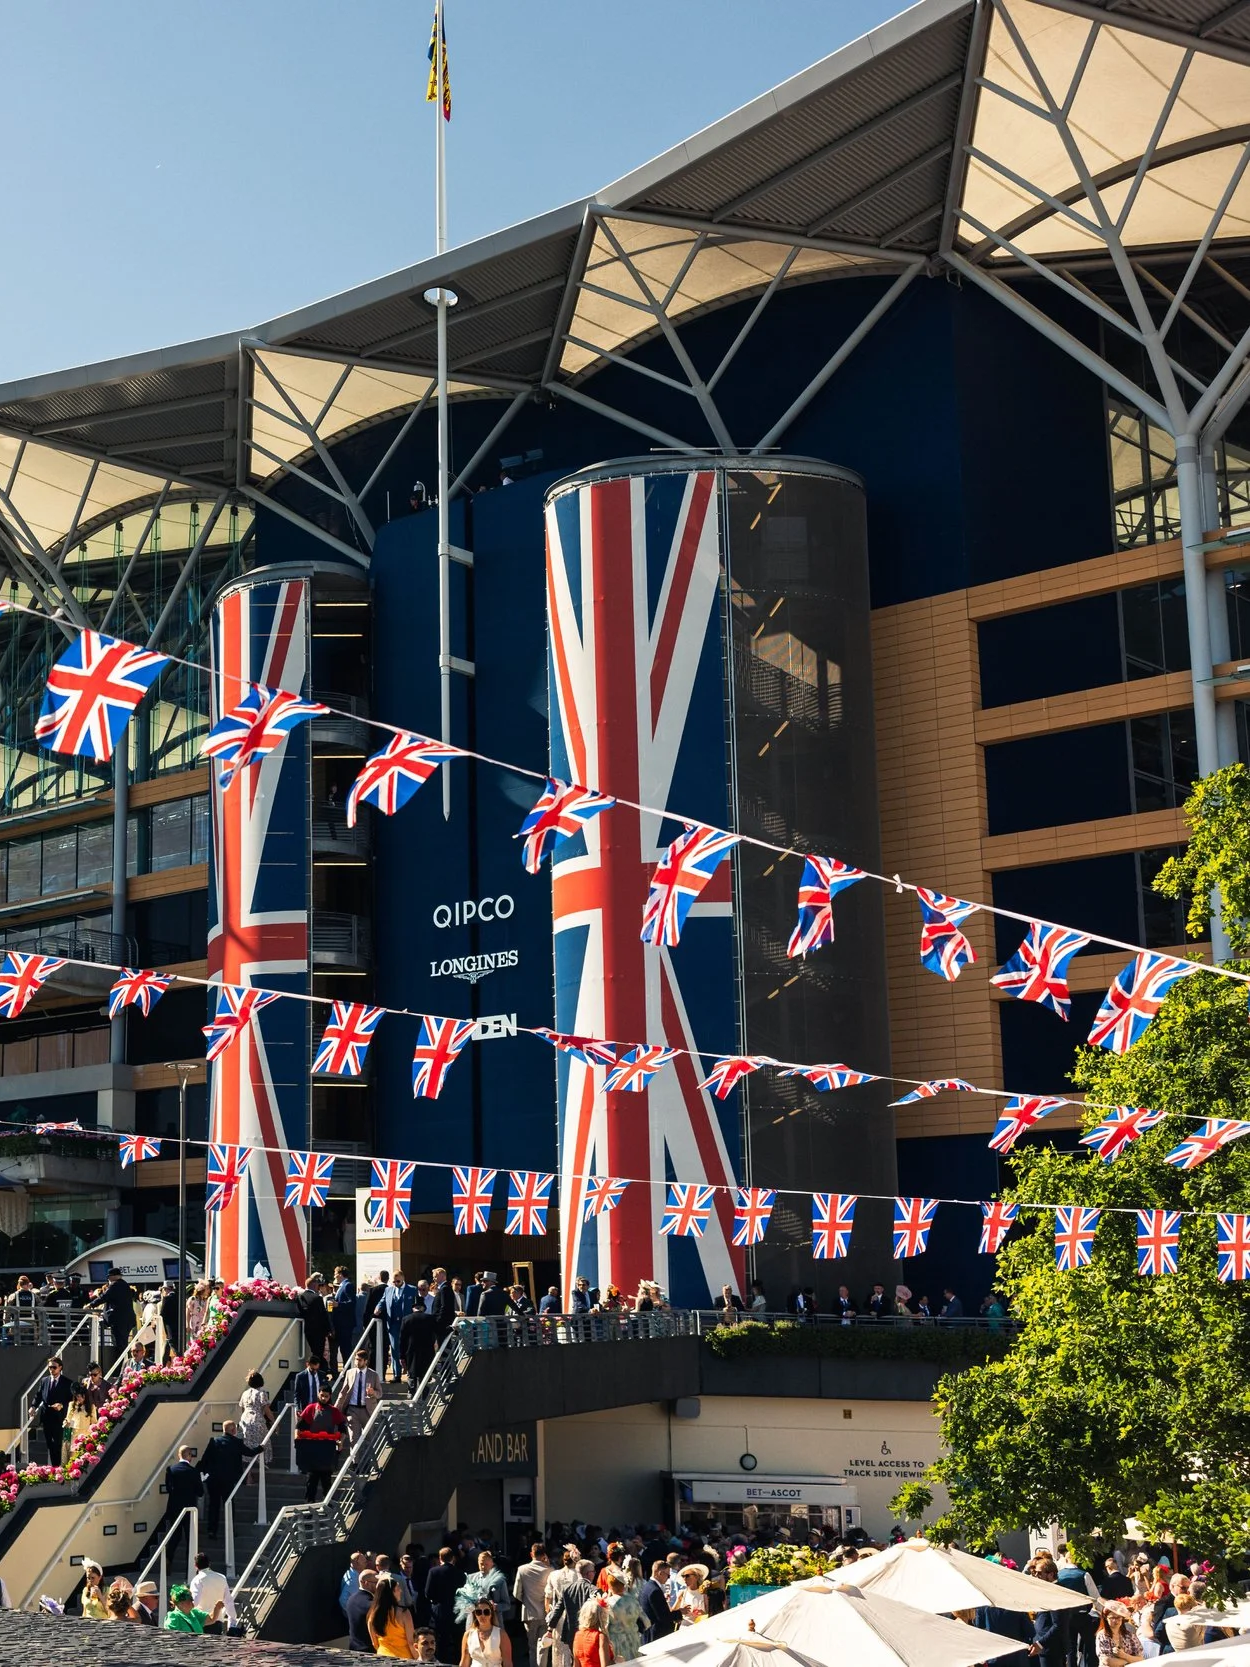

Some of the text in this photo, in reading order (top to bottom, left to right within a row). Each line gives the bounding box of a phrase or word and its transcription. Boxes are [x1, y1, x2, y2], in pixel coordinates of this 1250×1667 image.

[433, 895, 514, 928] QIPCO
[430, 950, 518, 977] LONGINES
[466, 1013, 517, 1041] DEN
[136, 1265, 158, 1273] ASCOT
[507, 1433, 528, 1462] BAR
[843, 1469, 871, 1477] TRACK
[746, 1488, 763, 1496] BET
[770, 1489, 801, 1497] ASCOT
